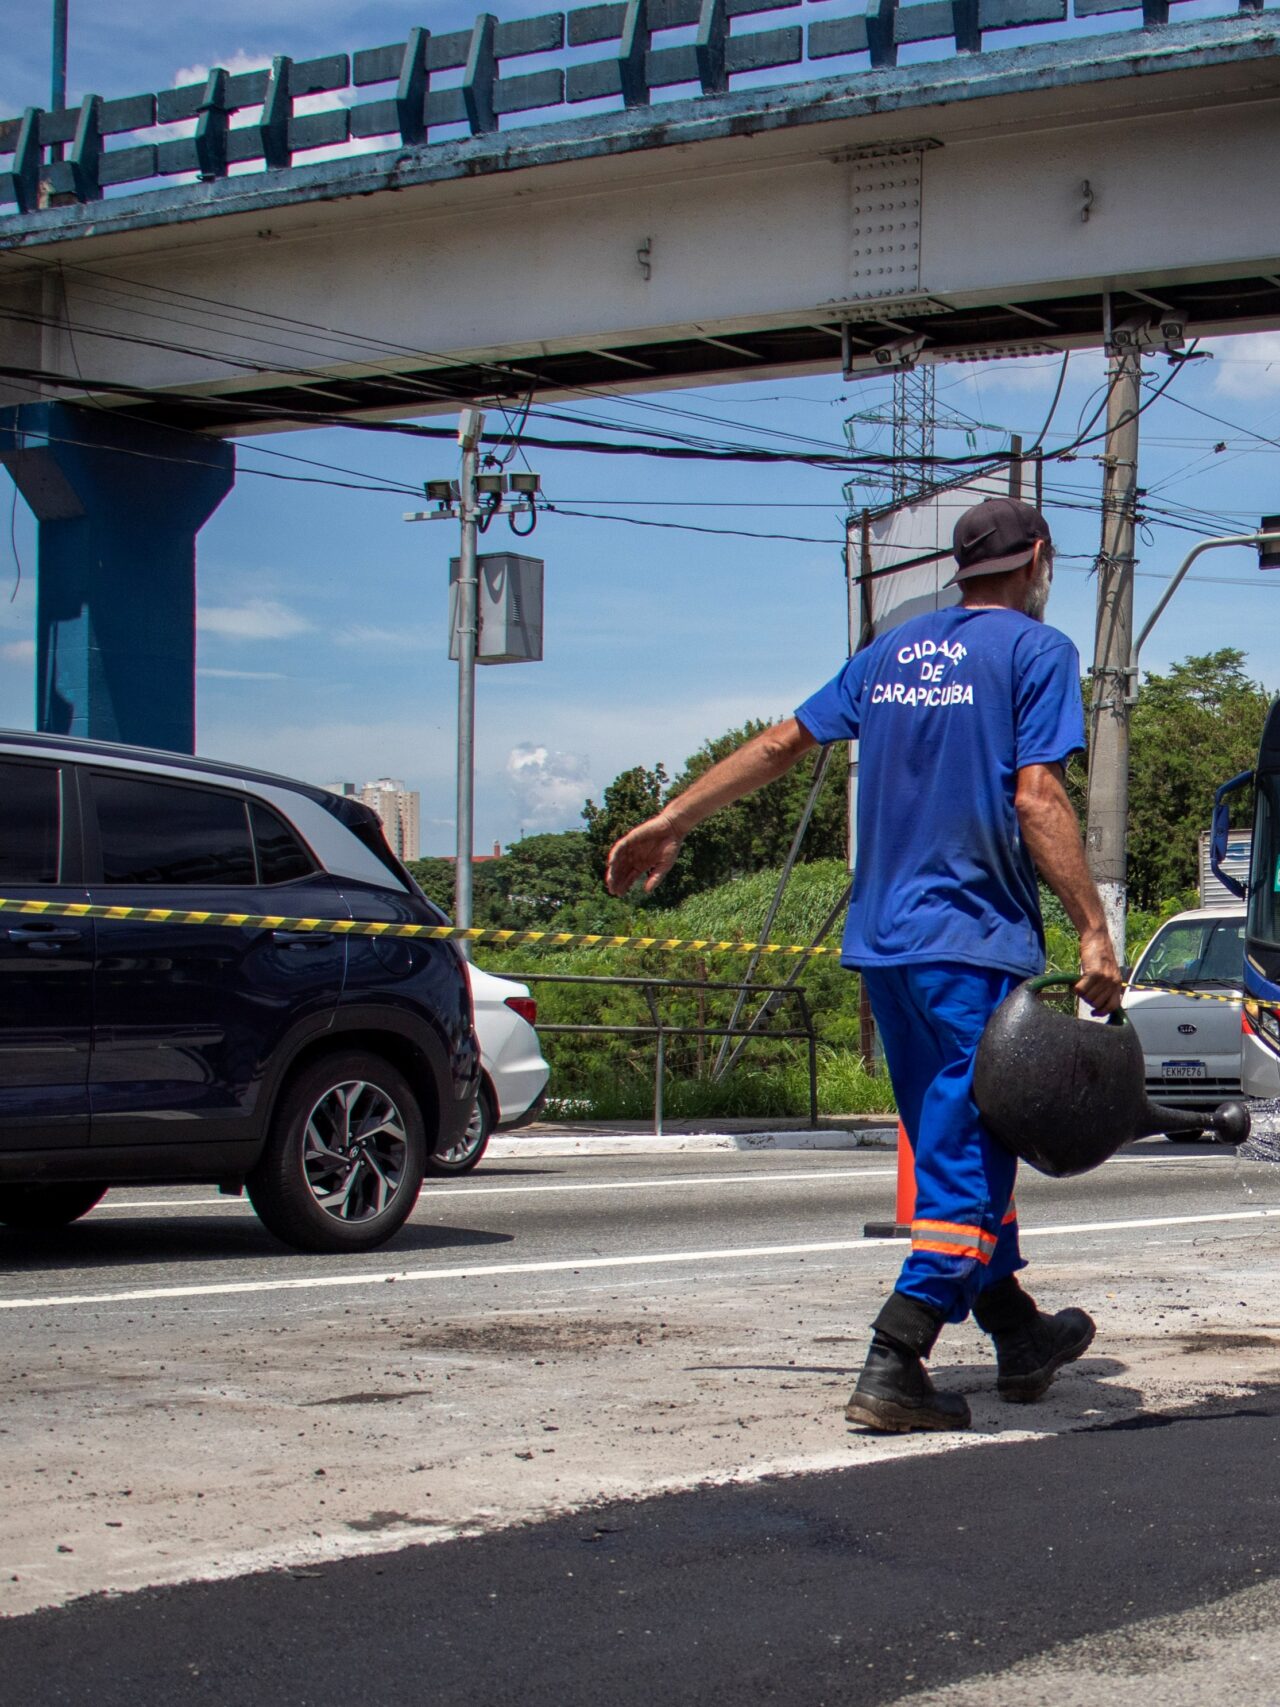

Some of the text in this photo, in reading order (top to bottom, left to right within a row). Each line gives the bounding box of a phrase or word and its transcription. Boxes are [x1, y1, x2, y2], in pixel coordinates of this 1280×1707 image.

[897, 639, 968, 666] CIDADE
[920, 662, 945, 682] DE
[871, 680, 974, 707] CARAPICUÍBA
[1166, 1067, 1202, 1077] EKH7E76
